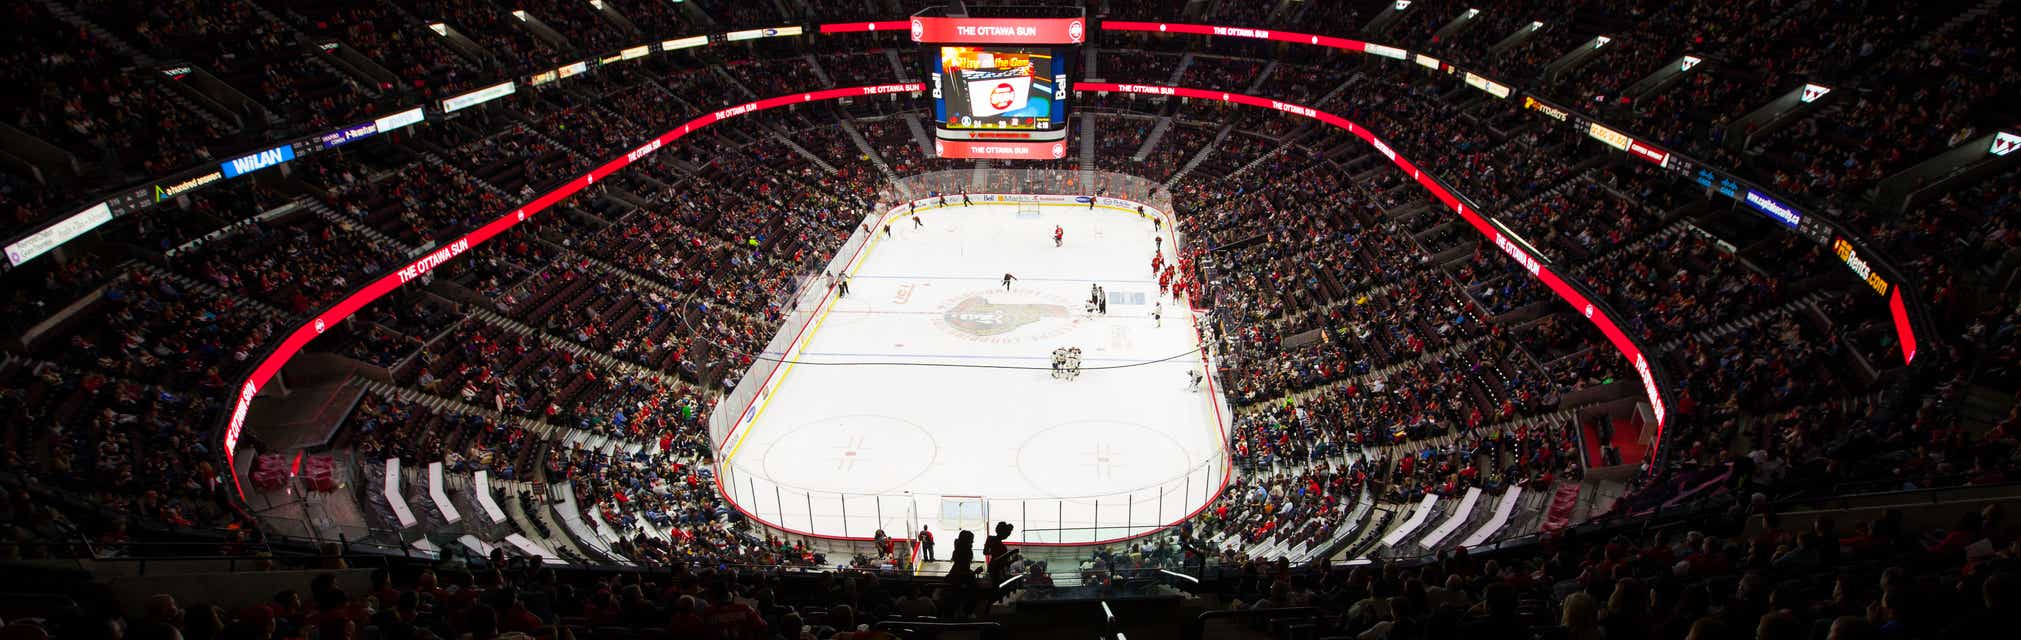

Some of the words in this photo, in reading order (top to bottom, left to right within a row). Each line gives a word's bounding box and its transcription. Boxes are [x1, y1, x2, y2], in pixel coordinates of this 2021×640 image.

[957, 26, 976, 36] THE
[977, 26, 1015, 36] OTTAWA
[1016, 26, 1036, 37] SUN
[1214, 26, 1227, 36] THE
[1228, 28, 1254, 37] OTTAWA
[1255, 30, 1269, 39] SUN
[863, 86, 876, 95] THE
[877, 84, 905, 93] OTTAWA
[905, 83, 920, 92] SUN
[932, 72, 942, 99] Bell
[1055, 74, 1066, 100] Bell
[1118, 84, 1132, 93] THE
[1133, 85, 1159, 94] OTTAWA
[1160, 87, 1175, 95] SUN
[715, 110, 726, 120] THE
[745, 102, 757, 113] SUN
[1272, 100, 1283, 110] THE
[1305, 108, 1317, 118] SUN
[972, 146, 985, 154] THE
[985, 146, 1014, 154] OTTAWA
[397, 264, 418, 284] THE
[417, 247, 452, 274] OTTAWA
[450, 237, 469, 256] SUN
[1496, 232, 1507, 251] THE
[1505, 241, 1528, 267] OTTAWA
[1526, 257, 1541, 277] SUN
